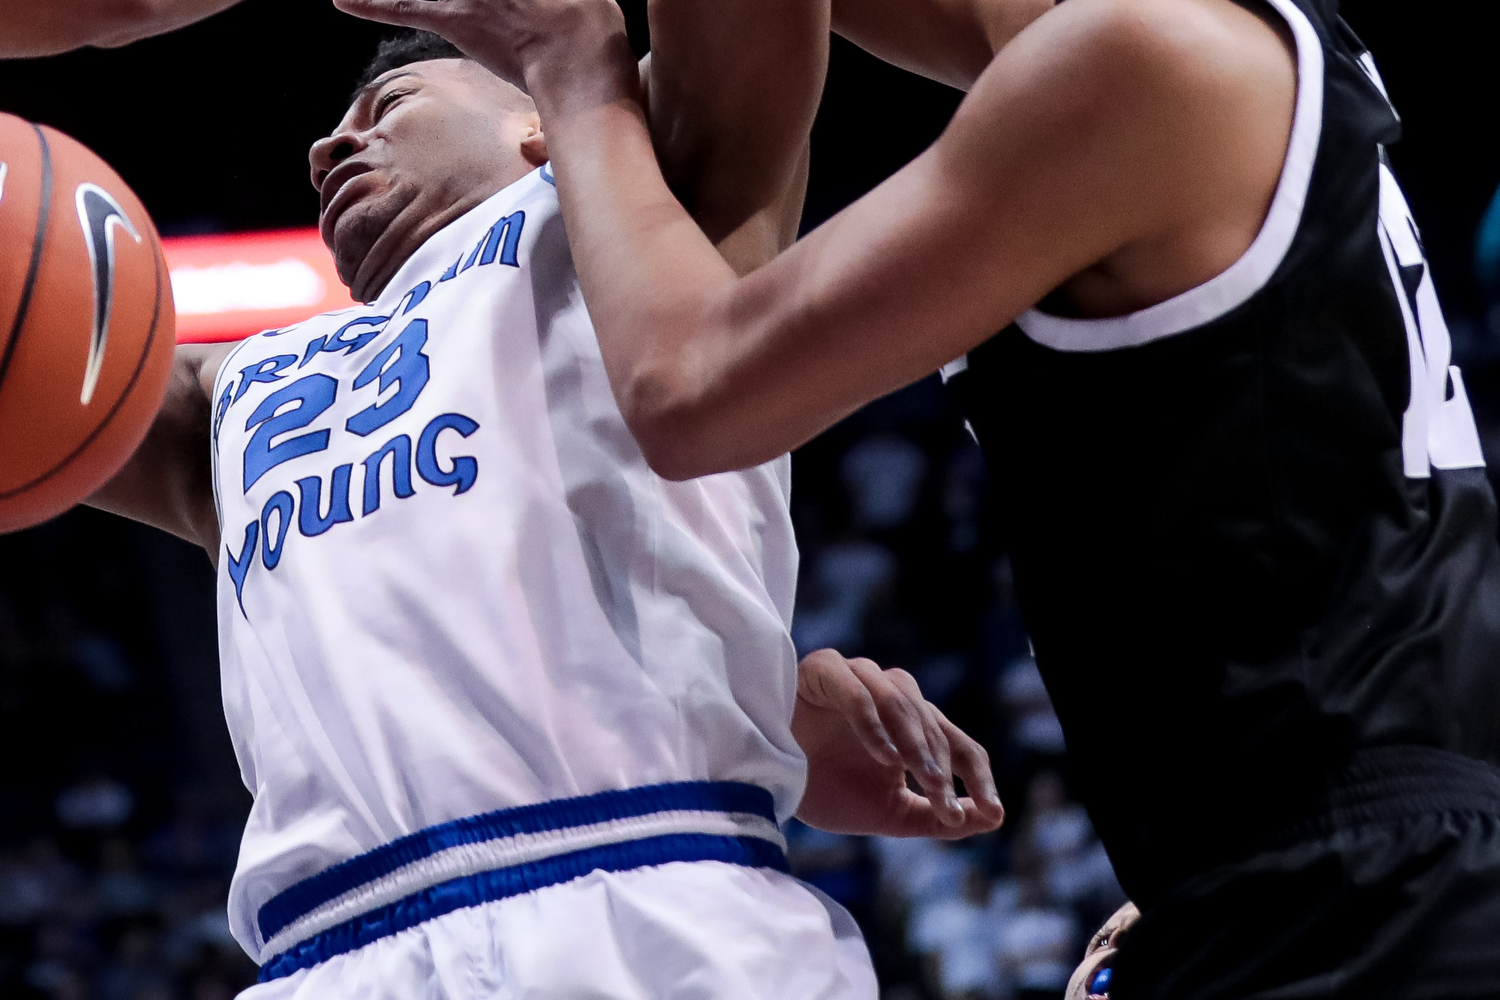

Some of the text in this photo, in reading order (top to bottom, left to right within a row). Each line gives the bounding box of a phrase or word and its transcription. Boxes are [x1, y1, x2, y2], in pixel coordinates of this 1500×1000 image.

[213, 209, 526, 448] BRIGM
[242, 317, 432, 496] 23
[226, 412, 481, 621] YOUNG
